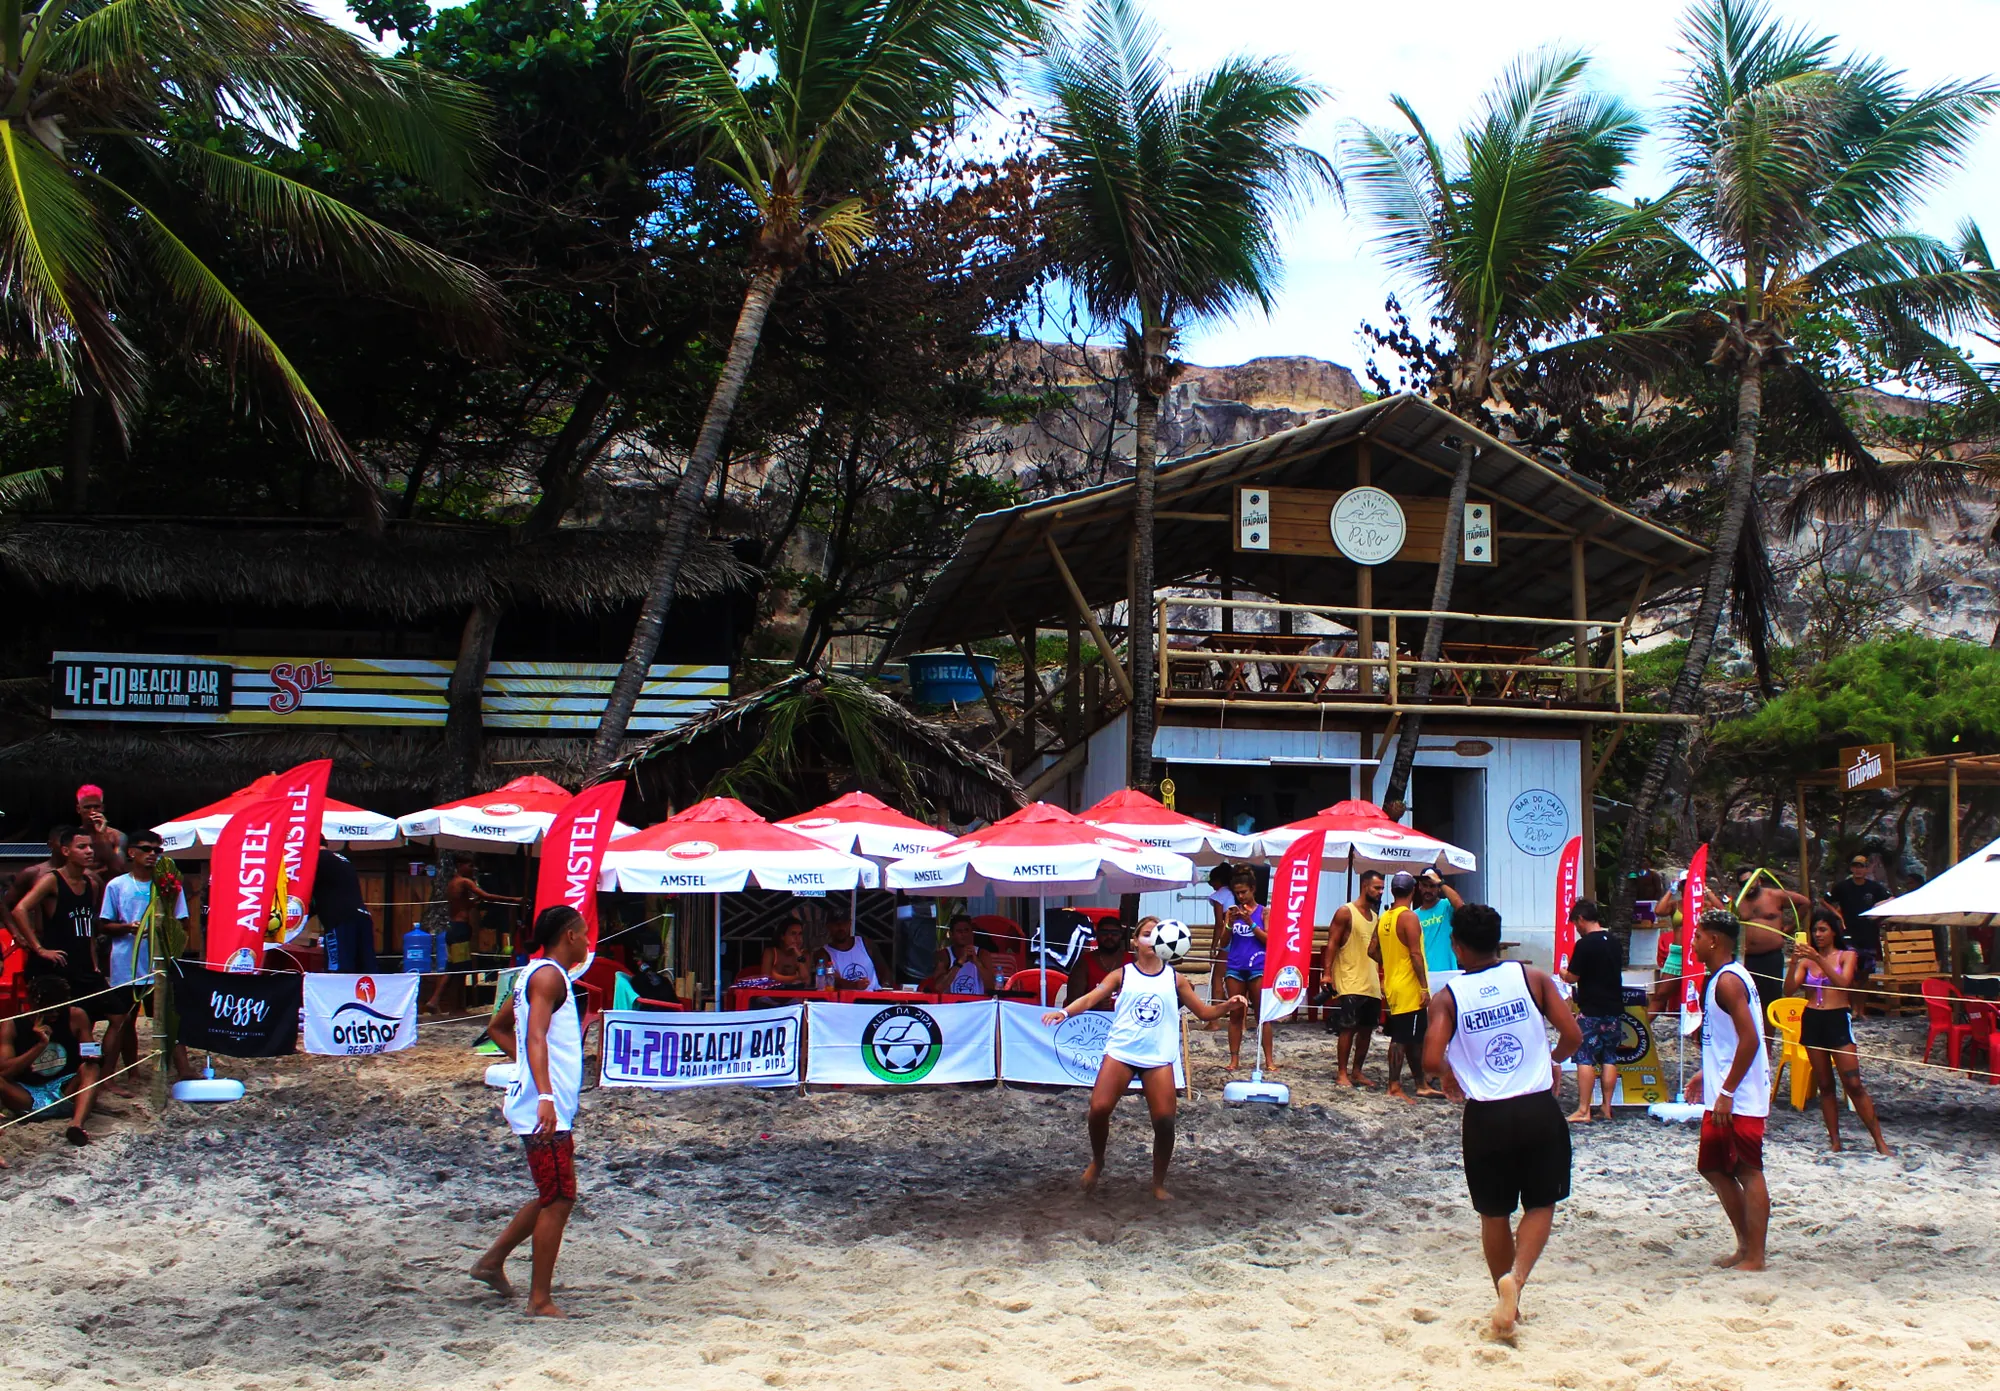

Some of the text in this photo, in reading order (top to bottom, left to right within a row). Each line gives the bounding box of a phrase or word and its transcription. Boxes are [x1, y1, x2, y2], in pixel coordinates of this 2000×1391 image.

[1243, 515, 1268, 527] ITAIPAVA
[1466, 529, 1490, 541] ITAIPAVA
[65, 666, 219, 705] 4:20 BEACH BAR
[128, 693, 151, 705] PRAIA
[154, 694, 165, 706] DO
[167, 694, 190, 706] AMOR
[201, 695, 219, 707] PIPA
[1847, 757, 1883, 789] ITAIPAVA
[1515, 795, 1564, 816] BAR DO CAIO
[338, 825, 369, 836] AMSTEL
[471, 824, 507, 837] AMSTEL
[1220, 841, 1237, 852] AMSTEL
[1380, 847, 1412, 858] AMSTEL
[1013, 864, 1059, 875] AMSTEL
[1135, 864, 1166, 875] AMSTEL
[237, 822, 271, 933] AMSTEL
[660, 875, 707, 886] AMSTEL
[787, 873, 826, 884] AMSTEL
[914, 870, 943, 882] AMSTEL
[1286, 853, 1311, 953] AMSTEL
[1278, 979, 1299, 987] AMSTEL
[210, 990, 270, 1026] nossa
[872, 1011, 891, 1029] ALTA
[914, 1010, 934, 1029] PIPA
[1465, 1001, 1525, 1031] 4:20 BEACH BAR
[1068, 1018, 1080, 1029] BAR
[613, 1026, 787, 1078] 4:20 BEACH BAR
[679, 1064, 708, 1078] PRAIA
[711, 1063, 724, 1076] DO
[726, 1061, 752, 1074] AMOR
[765, 1058, 787, 1072] PIPA
